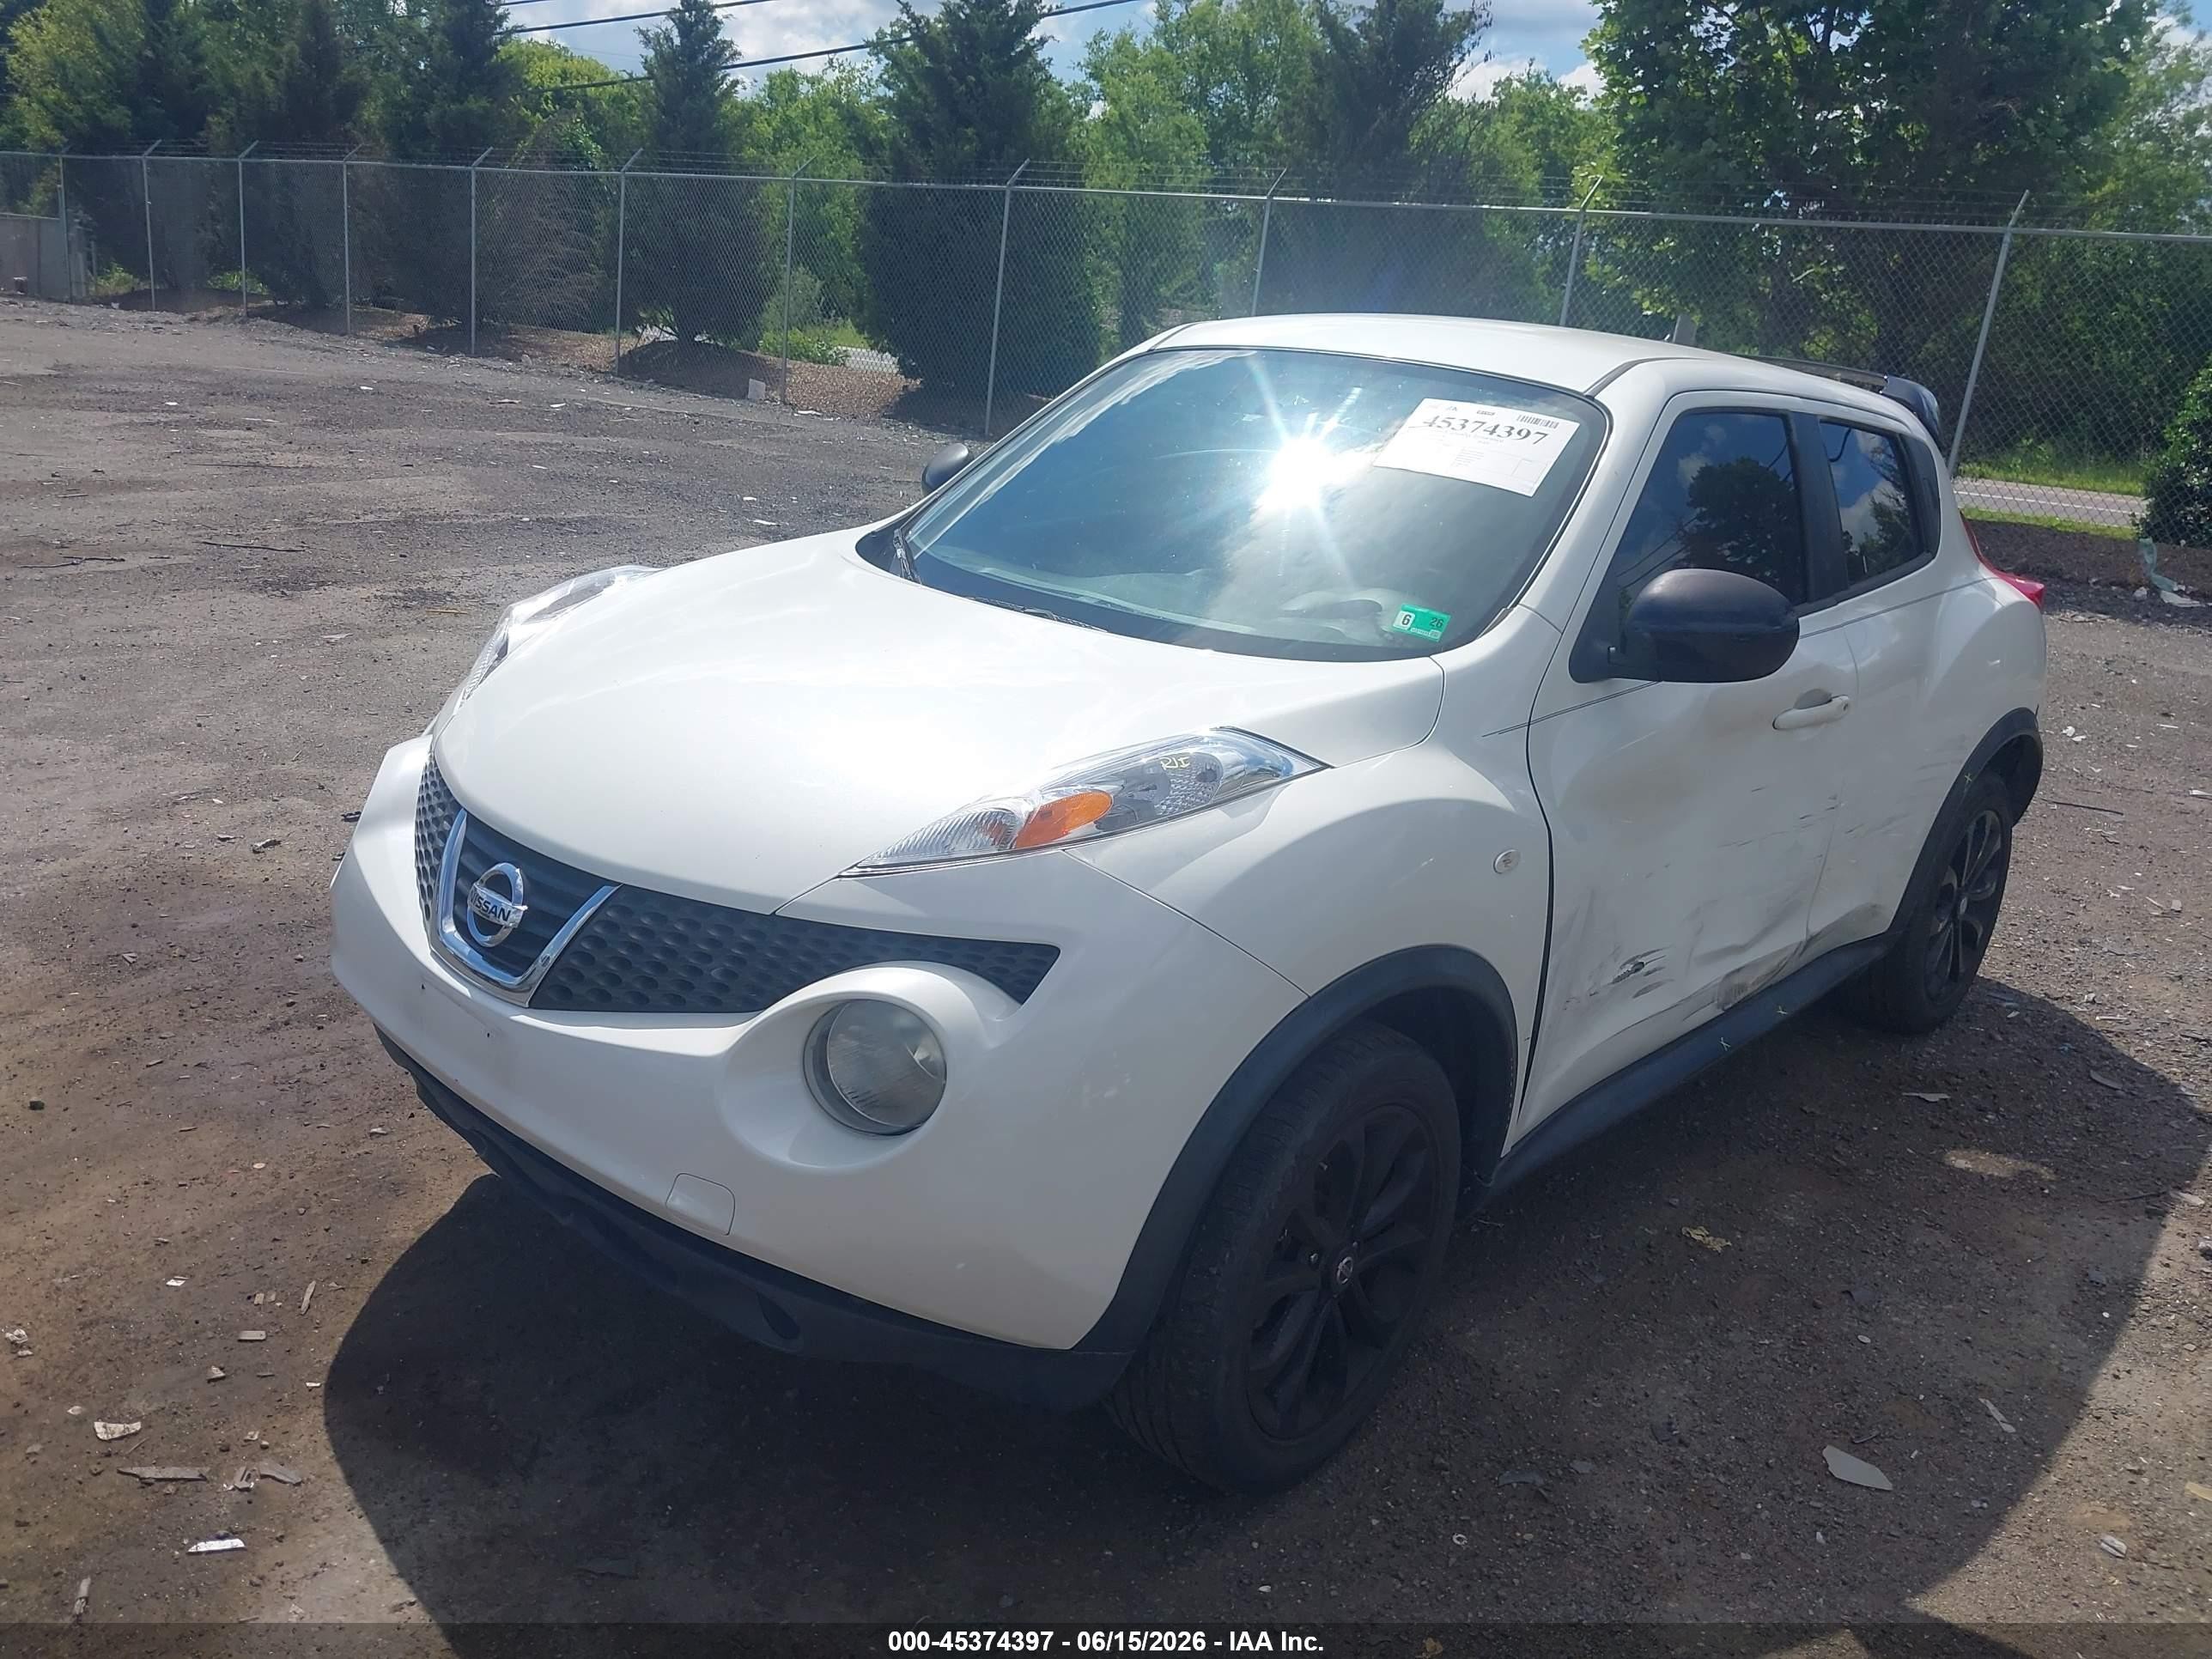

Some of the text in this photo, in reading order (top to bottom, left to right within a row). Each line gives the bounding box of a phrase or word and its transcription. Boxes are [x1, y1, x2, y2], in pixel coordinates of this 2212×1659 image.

[1422, 415, 1549, 445] 45374397
[1401, 614, 1411, 625] 6
[471, 888, 512, 921] NISSAN
